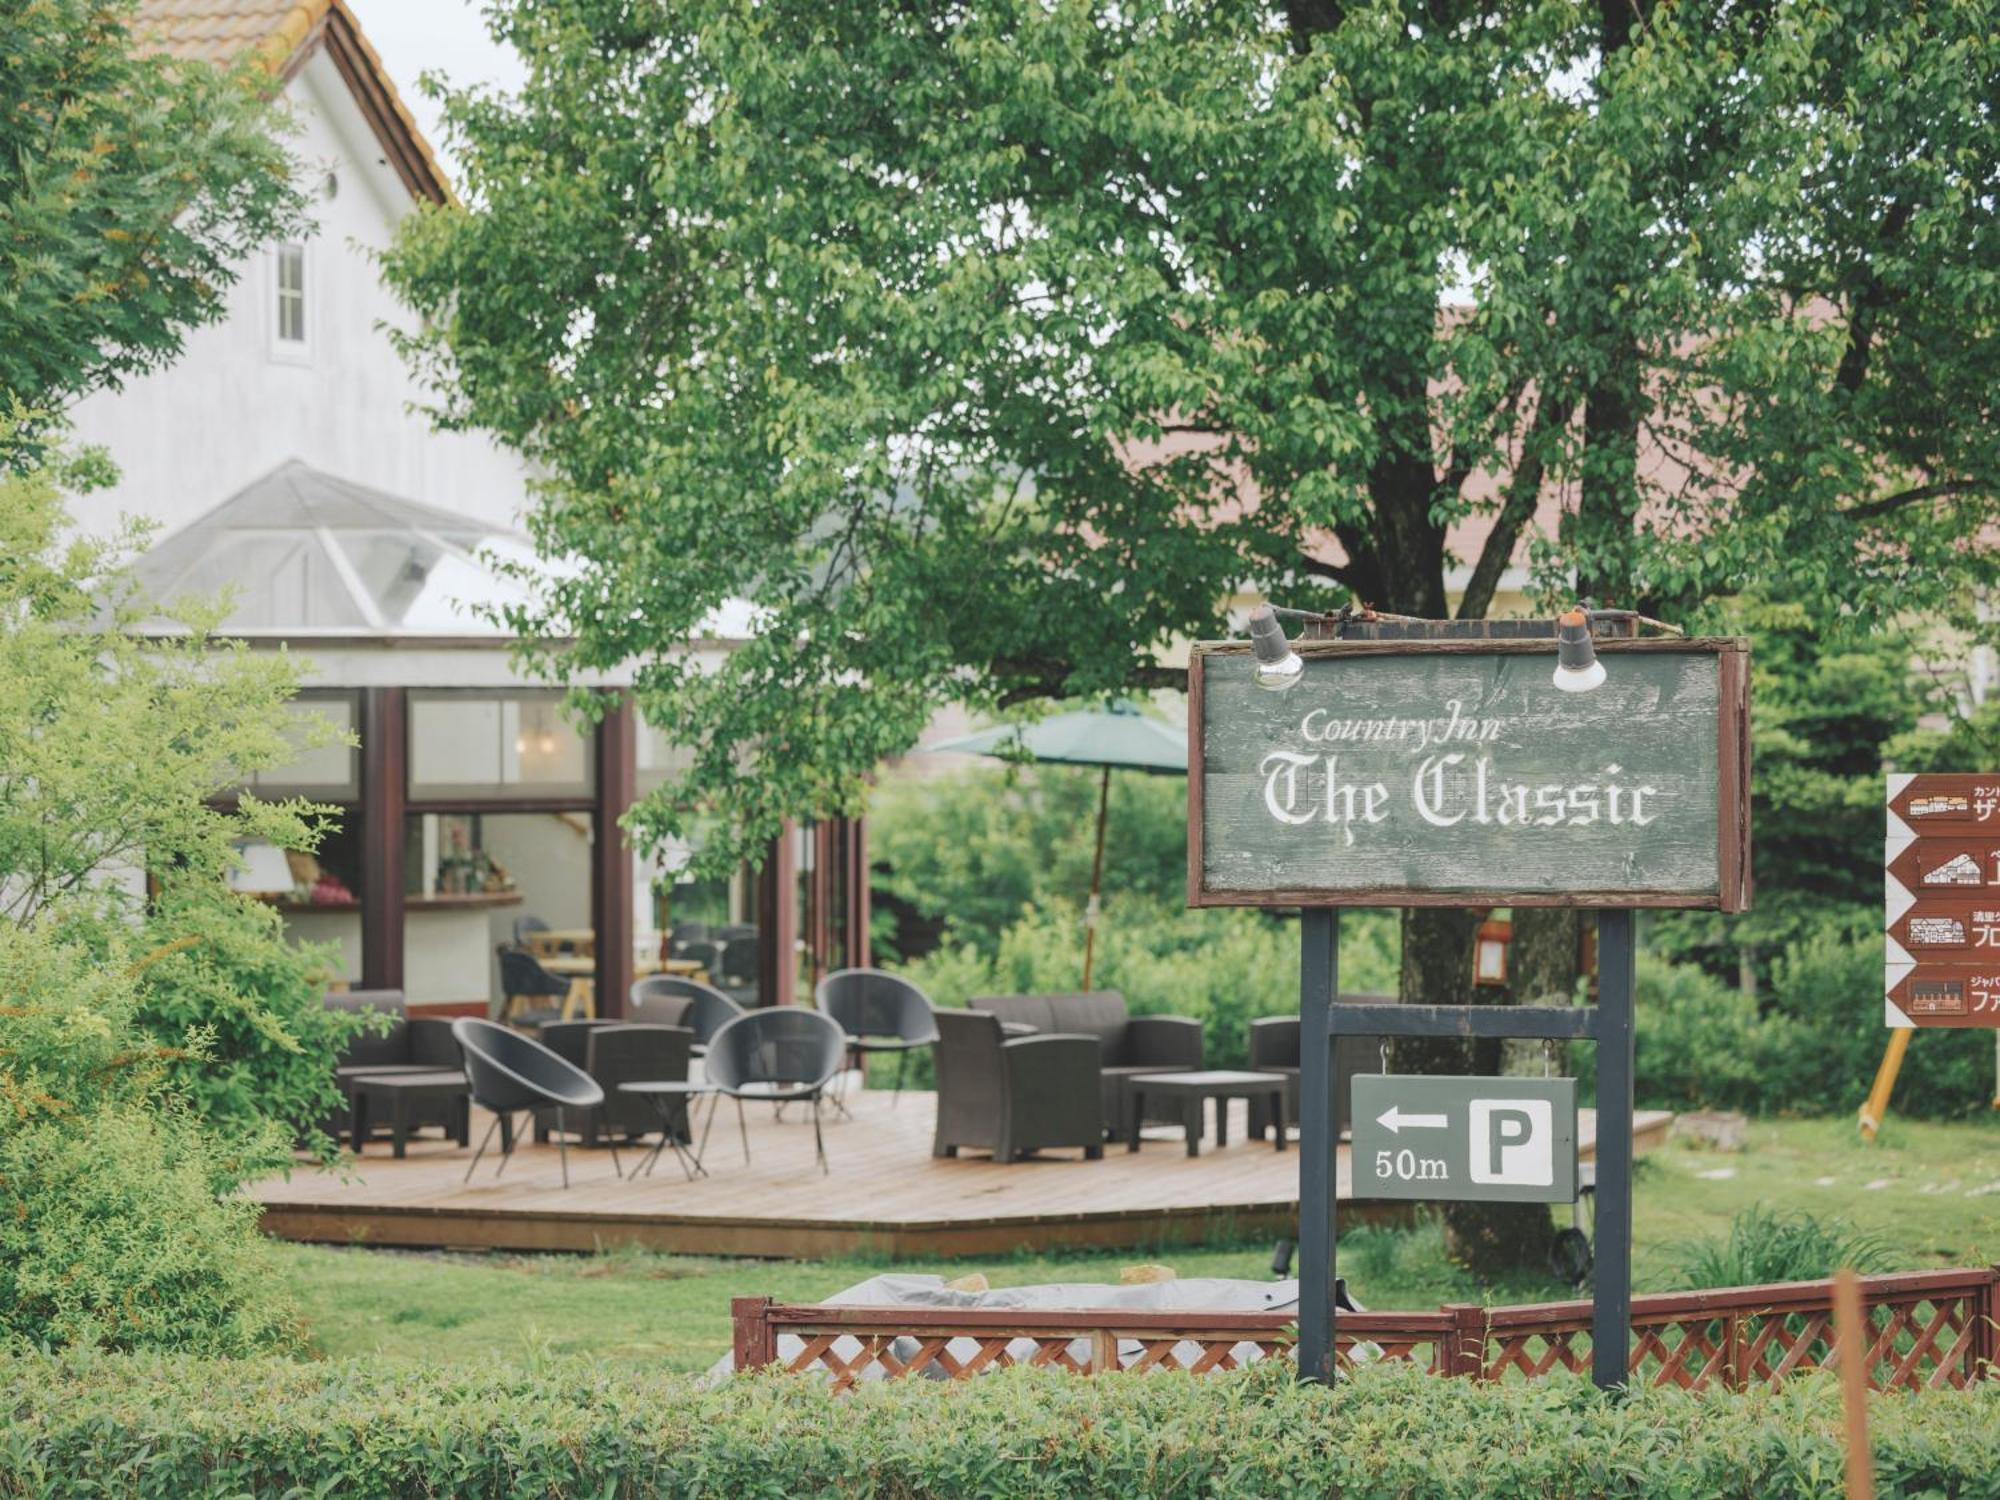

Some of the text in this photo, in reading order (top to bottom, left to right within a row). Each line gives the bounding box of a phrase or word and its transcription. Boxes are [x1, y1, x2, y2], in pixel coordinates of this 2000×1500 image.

[1301, 699, 1501, 753] Country Inn
[1260, 751, 1658, 847] The Classic
[1375, 1149, 1449, 1180] 50m
[1488, 1108, 1533, 1175] P
